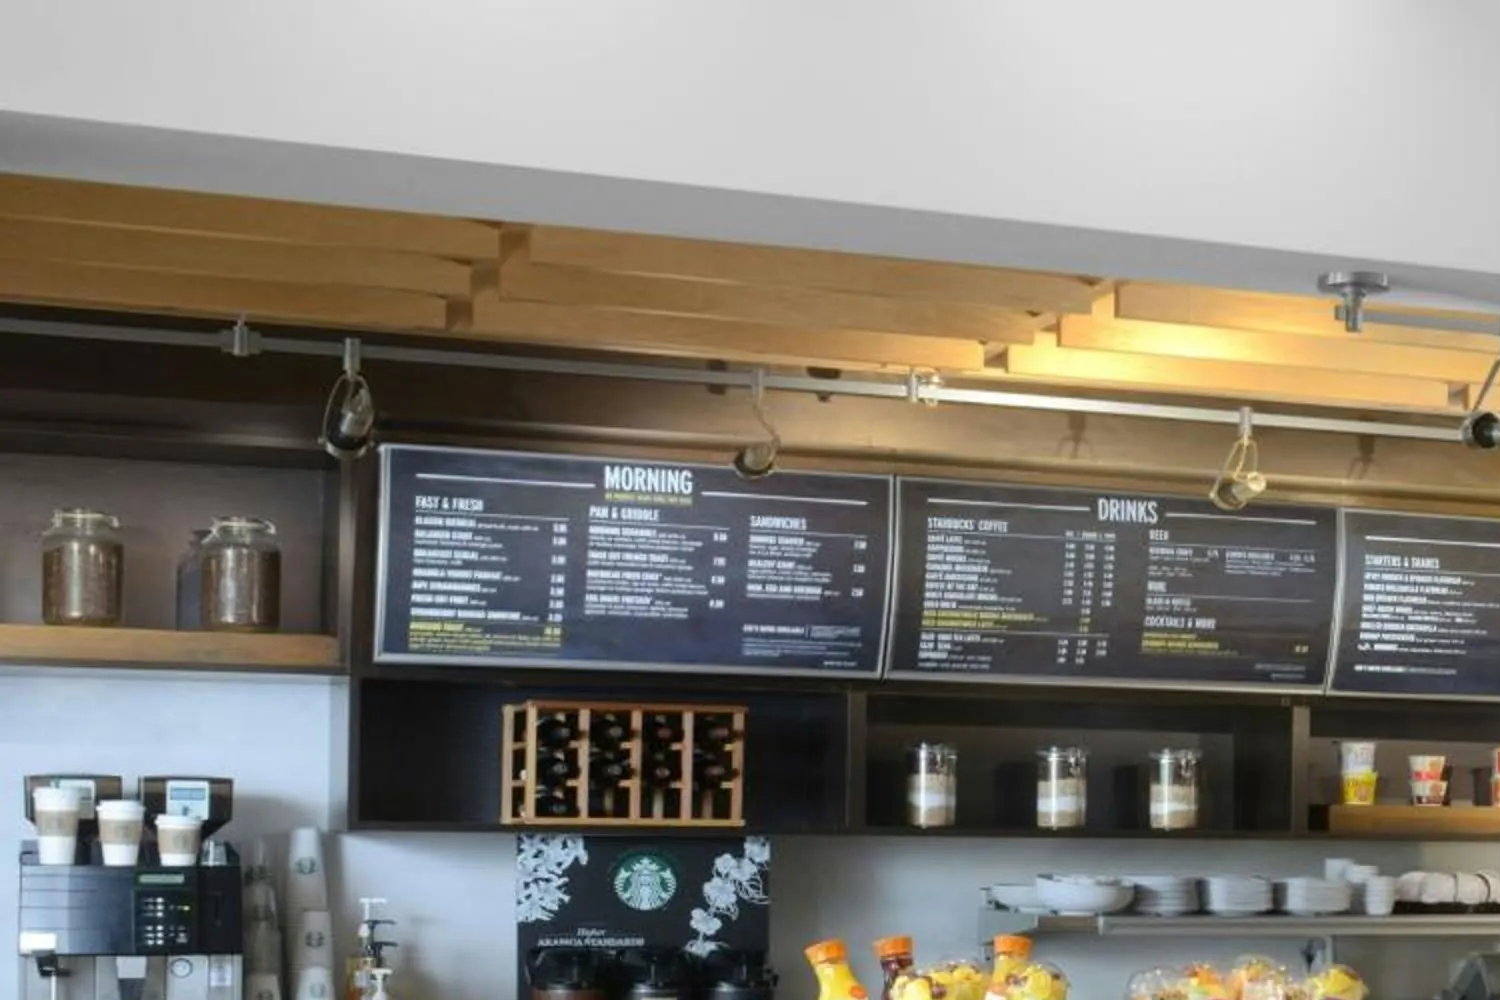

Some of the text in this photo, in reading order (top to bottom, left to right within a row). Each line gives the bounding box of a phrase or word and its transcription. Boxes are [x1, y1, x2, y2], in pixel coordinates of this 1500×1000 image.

[604, 465, 693, 495] MORNING
[415, 495, 440, 509] FAST
[452, 498, 484, 511] FRESH
[1098, 498, 1158, 524] DRINKS
